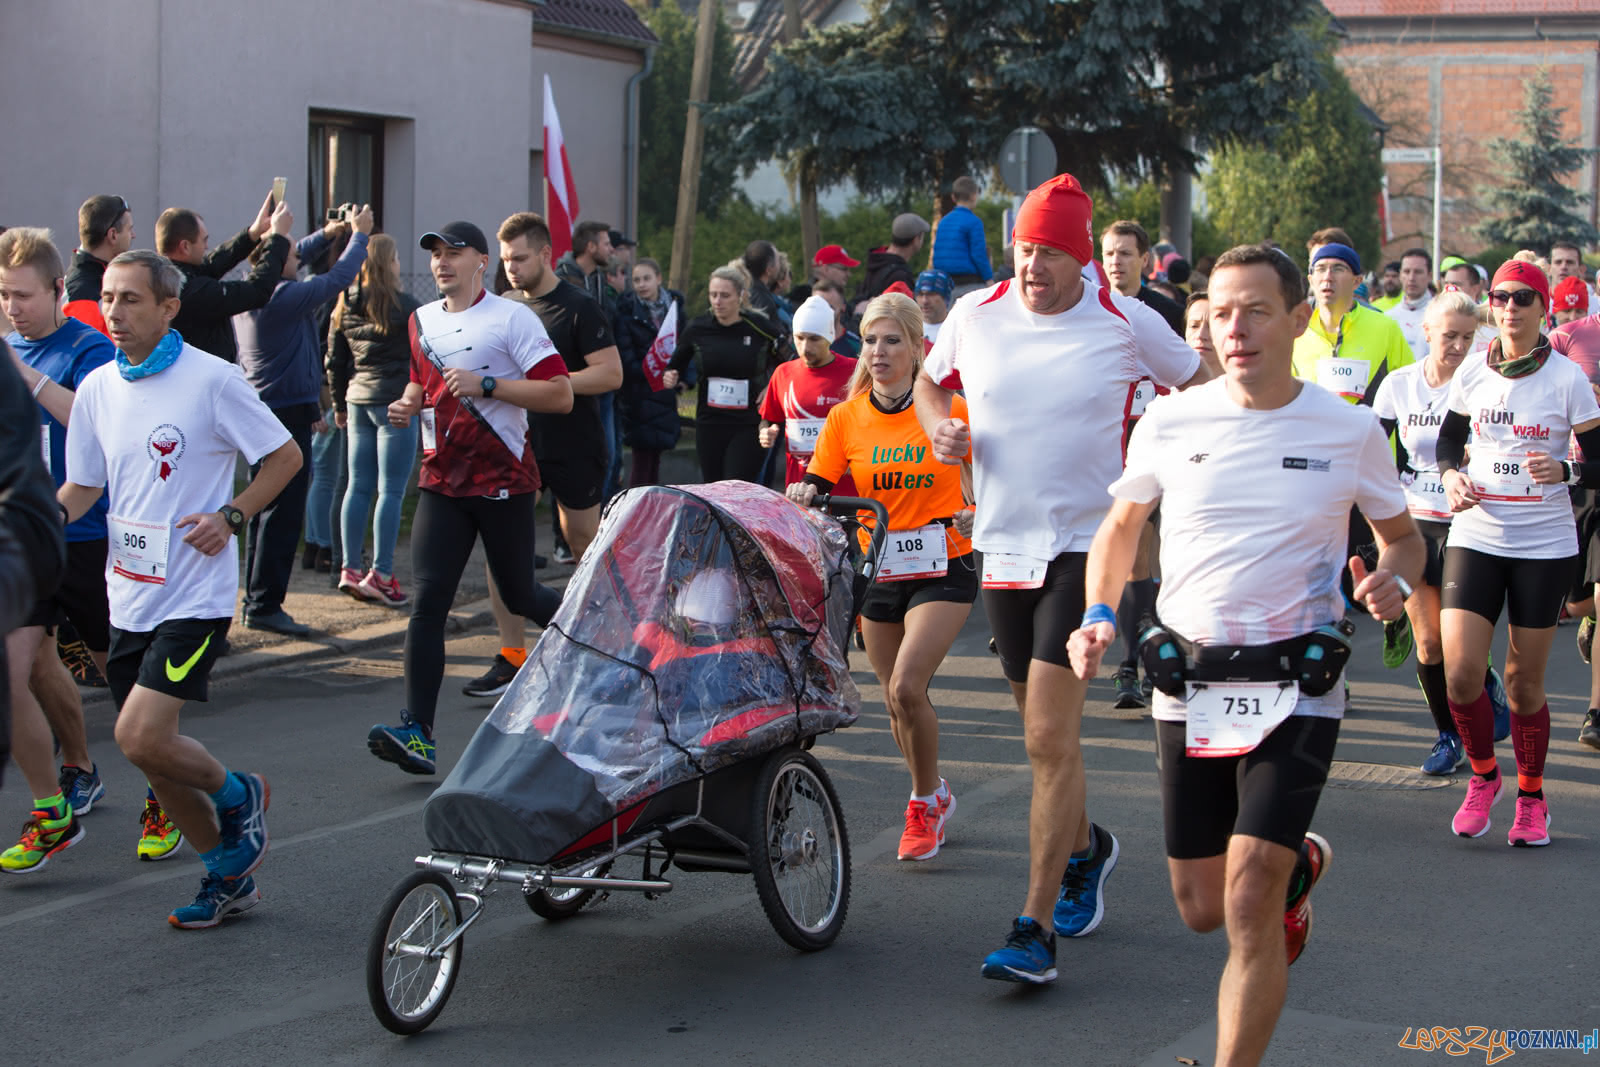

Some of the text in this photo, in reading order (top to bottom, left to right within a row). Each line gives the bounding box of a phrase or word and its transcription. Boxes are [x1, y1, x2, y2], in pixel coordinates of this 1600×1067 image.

[1332, 367, 1352, 376] 500
[720, 384, 734, 394] 773
[1408, 414, 1441, 426] RUN
[1479, 408, 1514, 425] RUN
[800, 428, 818, 436] 795
[872, 444, 926, 464] Lucky
[1189, 454, 1210, 464] 4F
[1494, 462, 1520, 475] 898
[873, 472, 935, 490] LUZers
[1422, 483, 1445, 494] 116
[124, 532, 146, 550] 906
[896, 538, 923, 552] 108
[1223, 697, 1262, 715] 751
